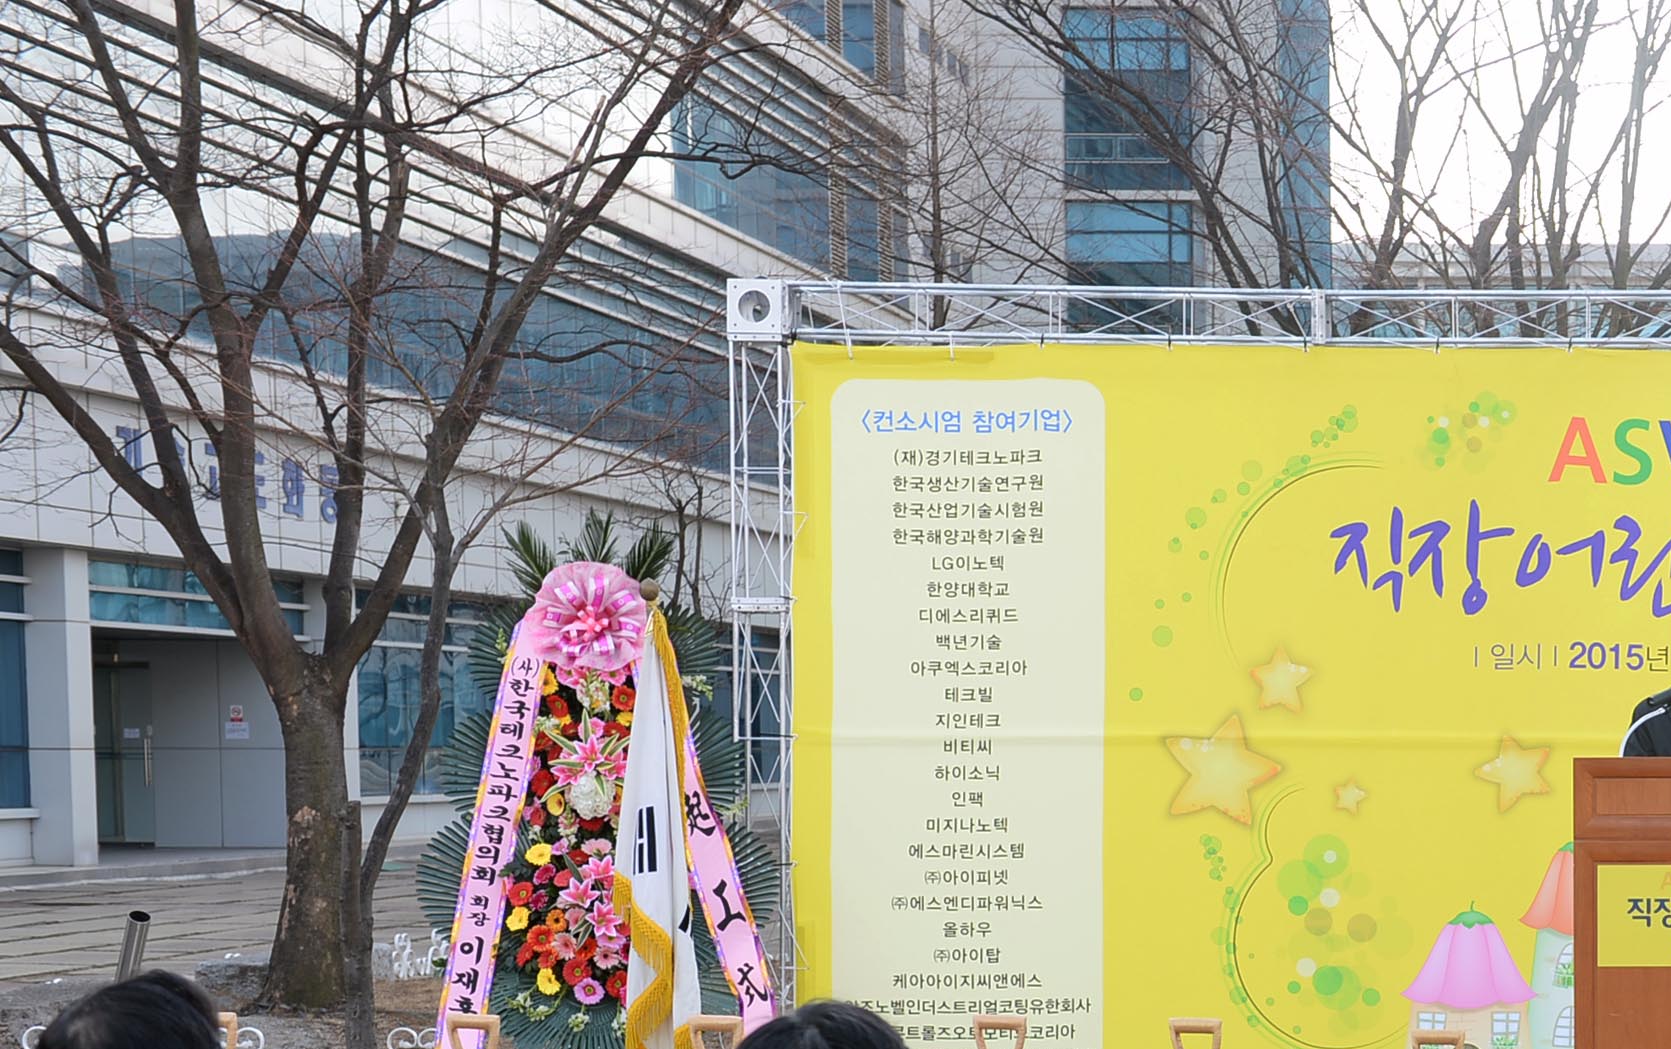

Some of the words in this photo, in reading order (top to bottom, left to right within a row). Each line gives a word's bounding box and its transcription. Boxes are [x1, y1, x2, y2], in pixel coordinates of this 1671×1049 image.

[893, 449, 1044, 467] (재)경기테크노파크
[892, 474, 1044, 493] 한국생산기술연구원
[892, 500, 1044, 519] 한국산업기술시험원
[892, 527, 1044, 546] 한국해양과학기술원
[932, 555, 1005, 572] LG이노텍
[926, 581, 1010, 598] 한양대학교
[918, 607, 1019, 625] 디에스리퀴드
[935, 634, 1003, 652] 백년기술
[1568, 641, 1670, 673] 2015년
[910, 660, 1027, 677] 아쿠엑스코리아
[944, 687, 993, 703] 테크빌
[935, 713, 1001, 729] 지인테크
[943, 738, 993, 756] 비티씨
[934, 765, 1001, 782] 하이소닉
[951, 791, 984, 808] 인팩
[925, 817, 1009, 834] 미지나노텍
[908, 842, 1025, 860] 에스마린시스템
[943, 921, 993, 939] 올하우
